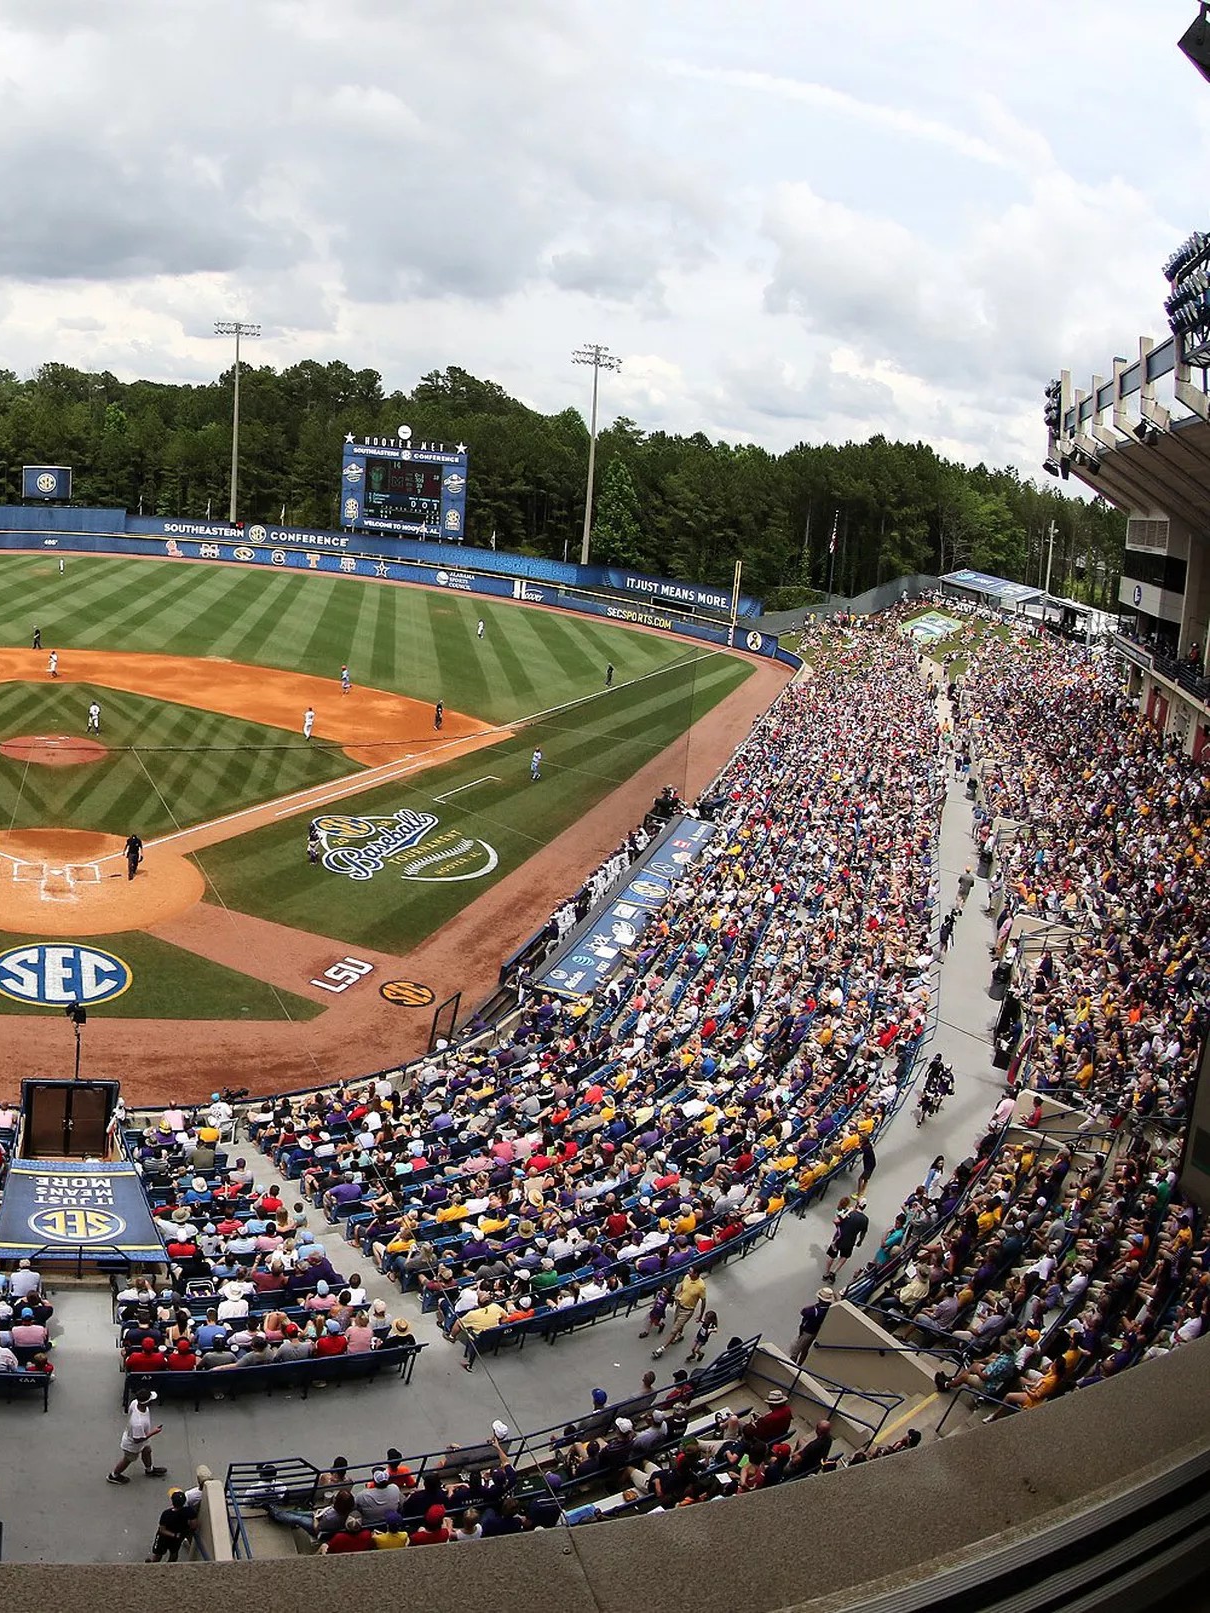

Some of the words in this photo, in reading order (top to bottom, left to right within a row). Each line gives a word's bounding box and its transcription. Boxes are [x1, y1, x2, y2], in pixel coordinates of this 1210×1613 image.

[353, 447, 399, 457] SOUTHEASTERN
[414, 453, 459, 463] CONFERENCE
[421, 441, 444, 452] MET
[363, 520, 393, 529] WELCOME
[164, 523, 245, 538] SOUTHEASTERN
[270, 531, 349, 547] CONFERENCE
[449, 571, 476, 581] ALABAMA
[448, 582, 472, 591] COUNCIL
[511, 580, 544, 602] Hoover
[626, 577, 635, 588] IT
[635, 578, 659, 594] JUST
[661, 585, 695, 601] MEANS
[697, 592, 729, 609] MORE.
[606, 606, 672, 630] SECSPORTS.COM
[322, 809, 439, 880] Baseball
[388, 828, 464, 866] TOURNAMENT
[0, 947, 118, 1001] SEC
[309, 955, 375, 993] LSU
[28, 1176, 111, 1187] MORE.
[35, 1188, 113, 1197] MEANS
[35, 1196, 90, 1205] JUST
[94, 1197, 115, 1205] IT
[42, 1210, 112, 1237] SEC
